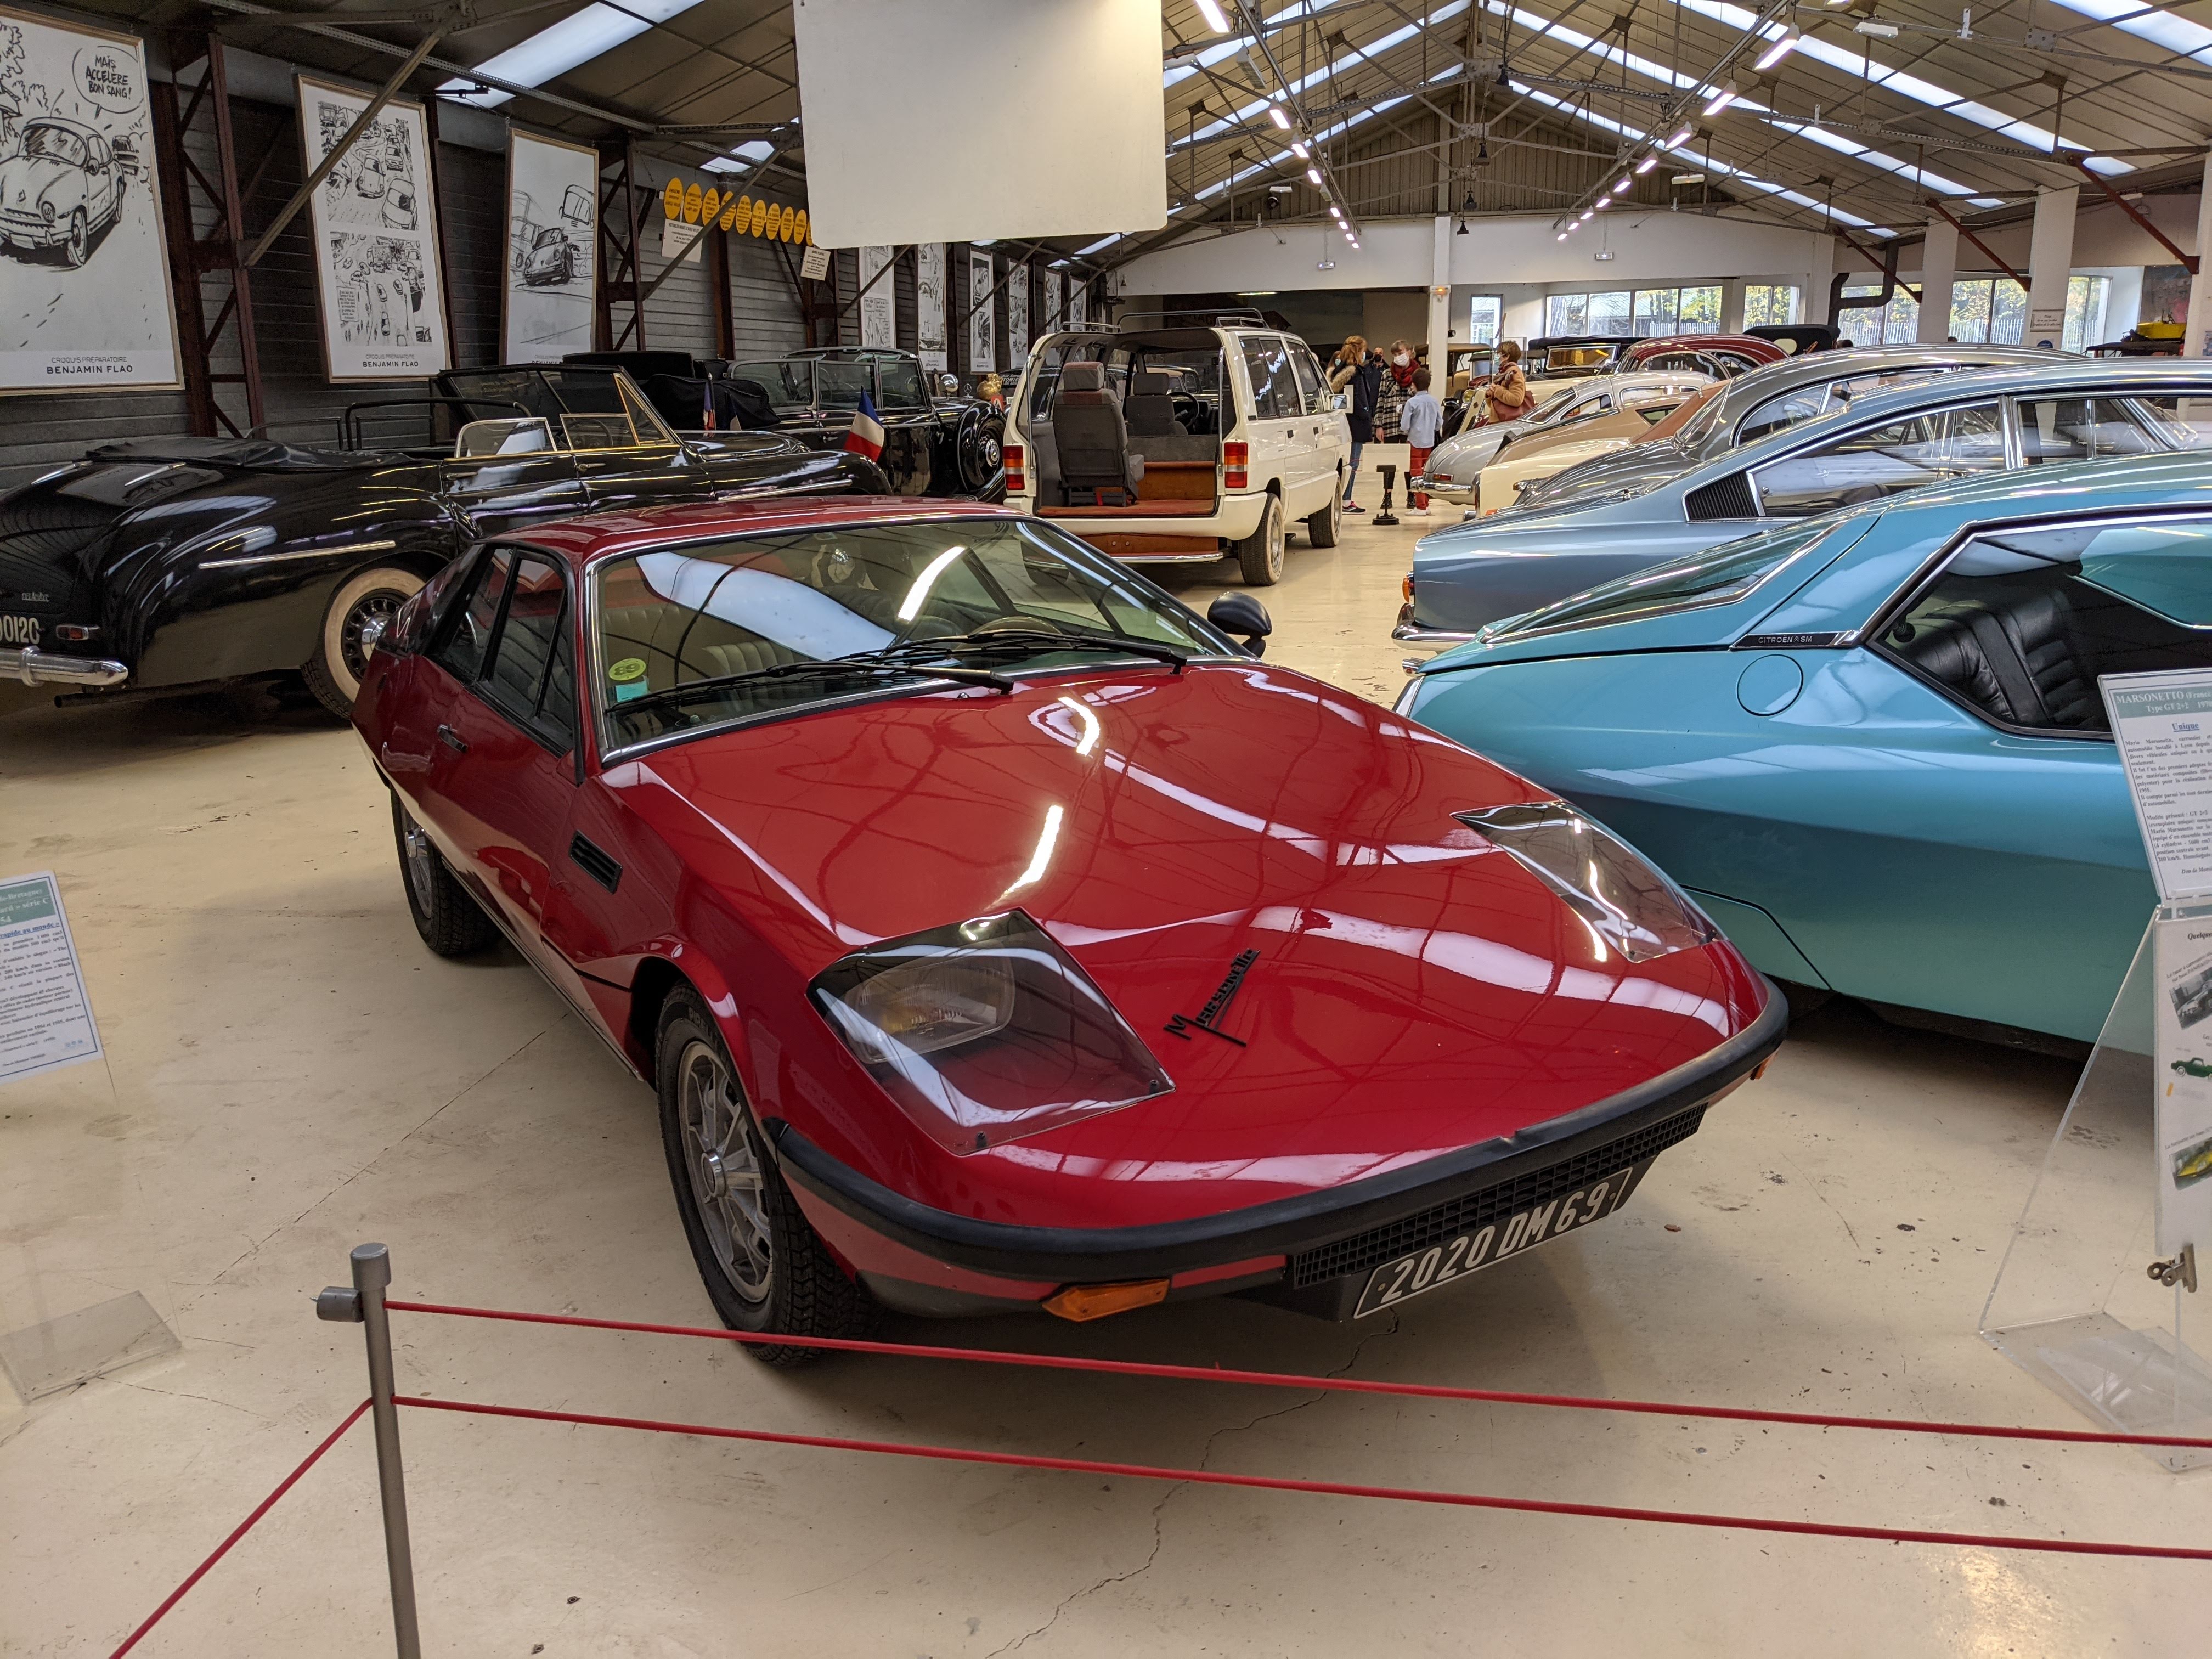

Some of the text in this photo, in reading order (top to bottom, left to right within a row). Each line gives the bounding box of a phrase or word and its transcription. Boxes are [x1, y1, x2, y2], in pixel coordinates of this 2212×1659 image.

[88, 81, 104, 94] BON
[1758, 635, 1793, 644] CITROËN
[2115, 691, 2185, 704] MARSONETTO
[2146, 705, 2164, 713] Type
[2164, 702, 2176, 710] GT
[2171, 723, 2200, 732] Unique
[32, 922, 54, 932] monde
[1380, 1182, 1610, 1305] 2020 DM 69
